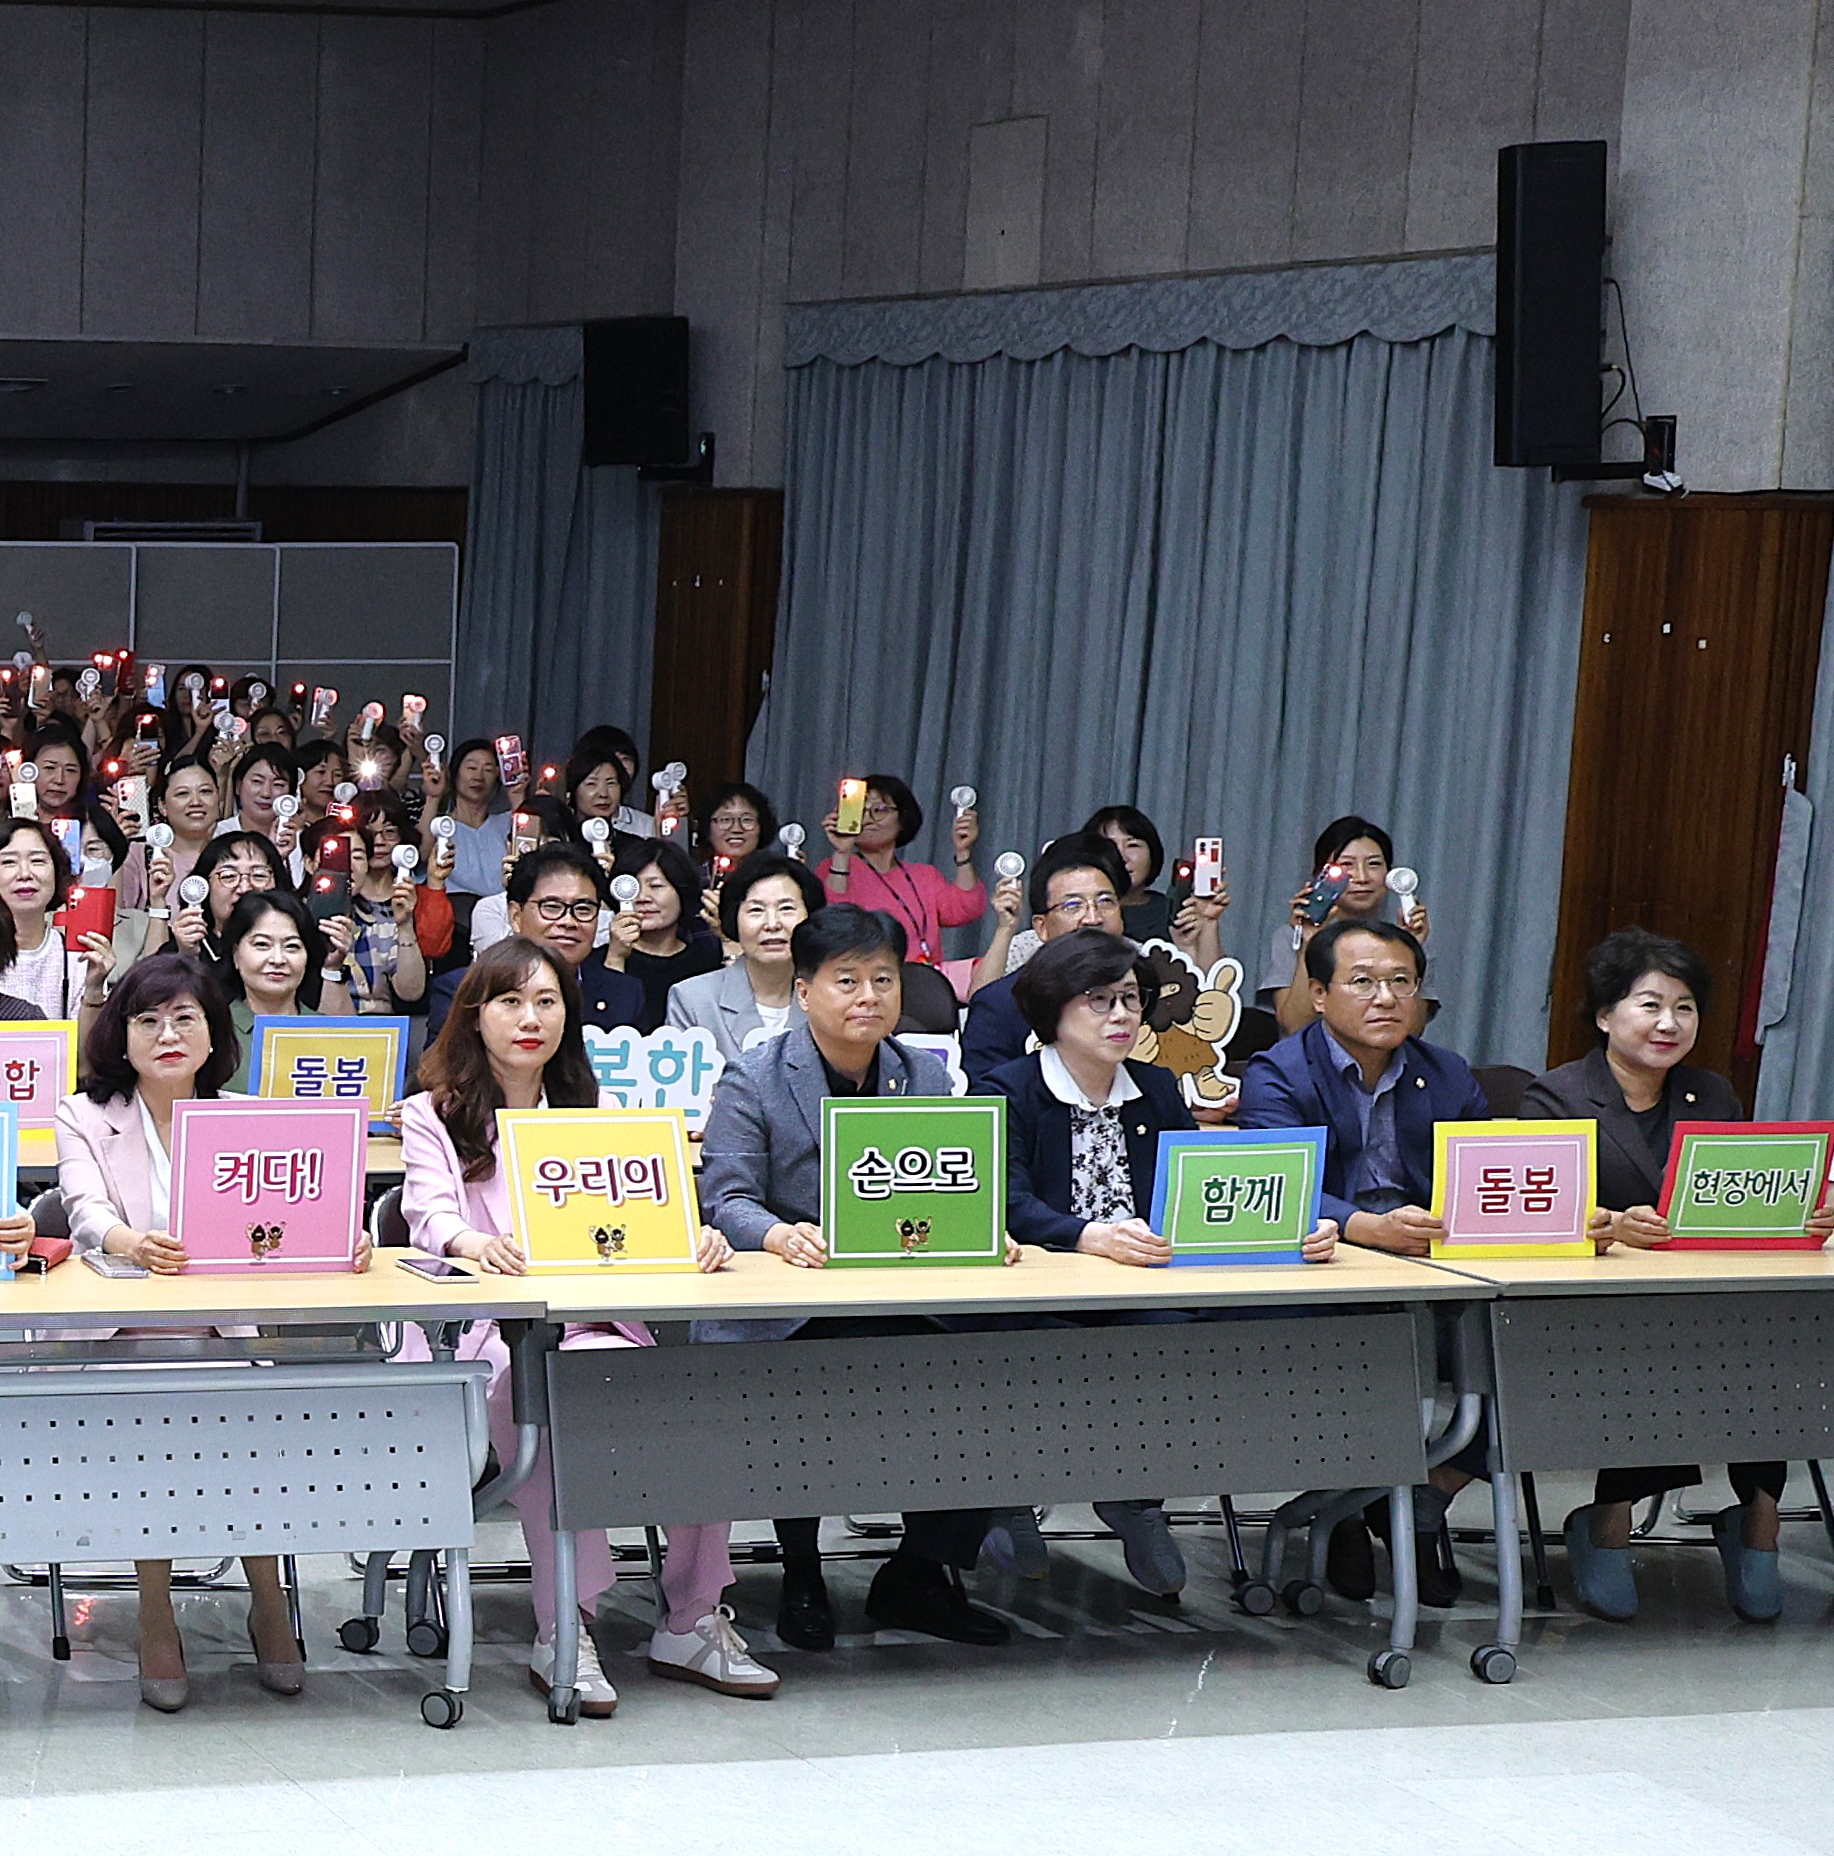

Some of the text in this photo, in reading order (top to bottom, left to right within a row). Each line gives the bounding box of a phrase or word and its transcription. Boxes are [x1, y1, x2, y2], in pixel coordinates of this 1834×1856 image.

[288, 1054, 368, 1098] 돌봄
[213, 1149, 322, 1204] 켜다!
[533, 1152, 669, 1207] 우리의
[848, 1146, 981, 1200] 손으로
[1200, 1172, 1285, 1225] 함께
[1476, 1165, 1561, 1215] 돌봄
[1691, 1166, 1812, 1208] 현장에서
